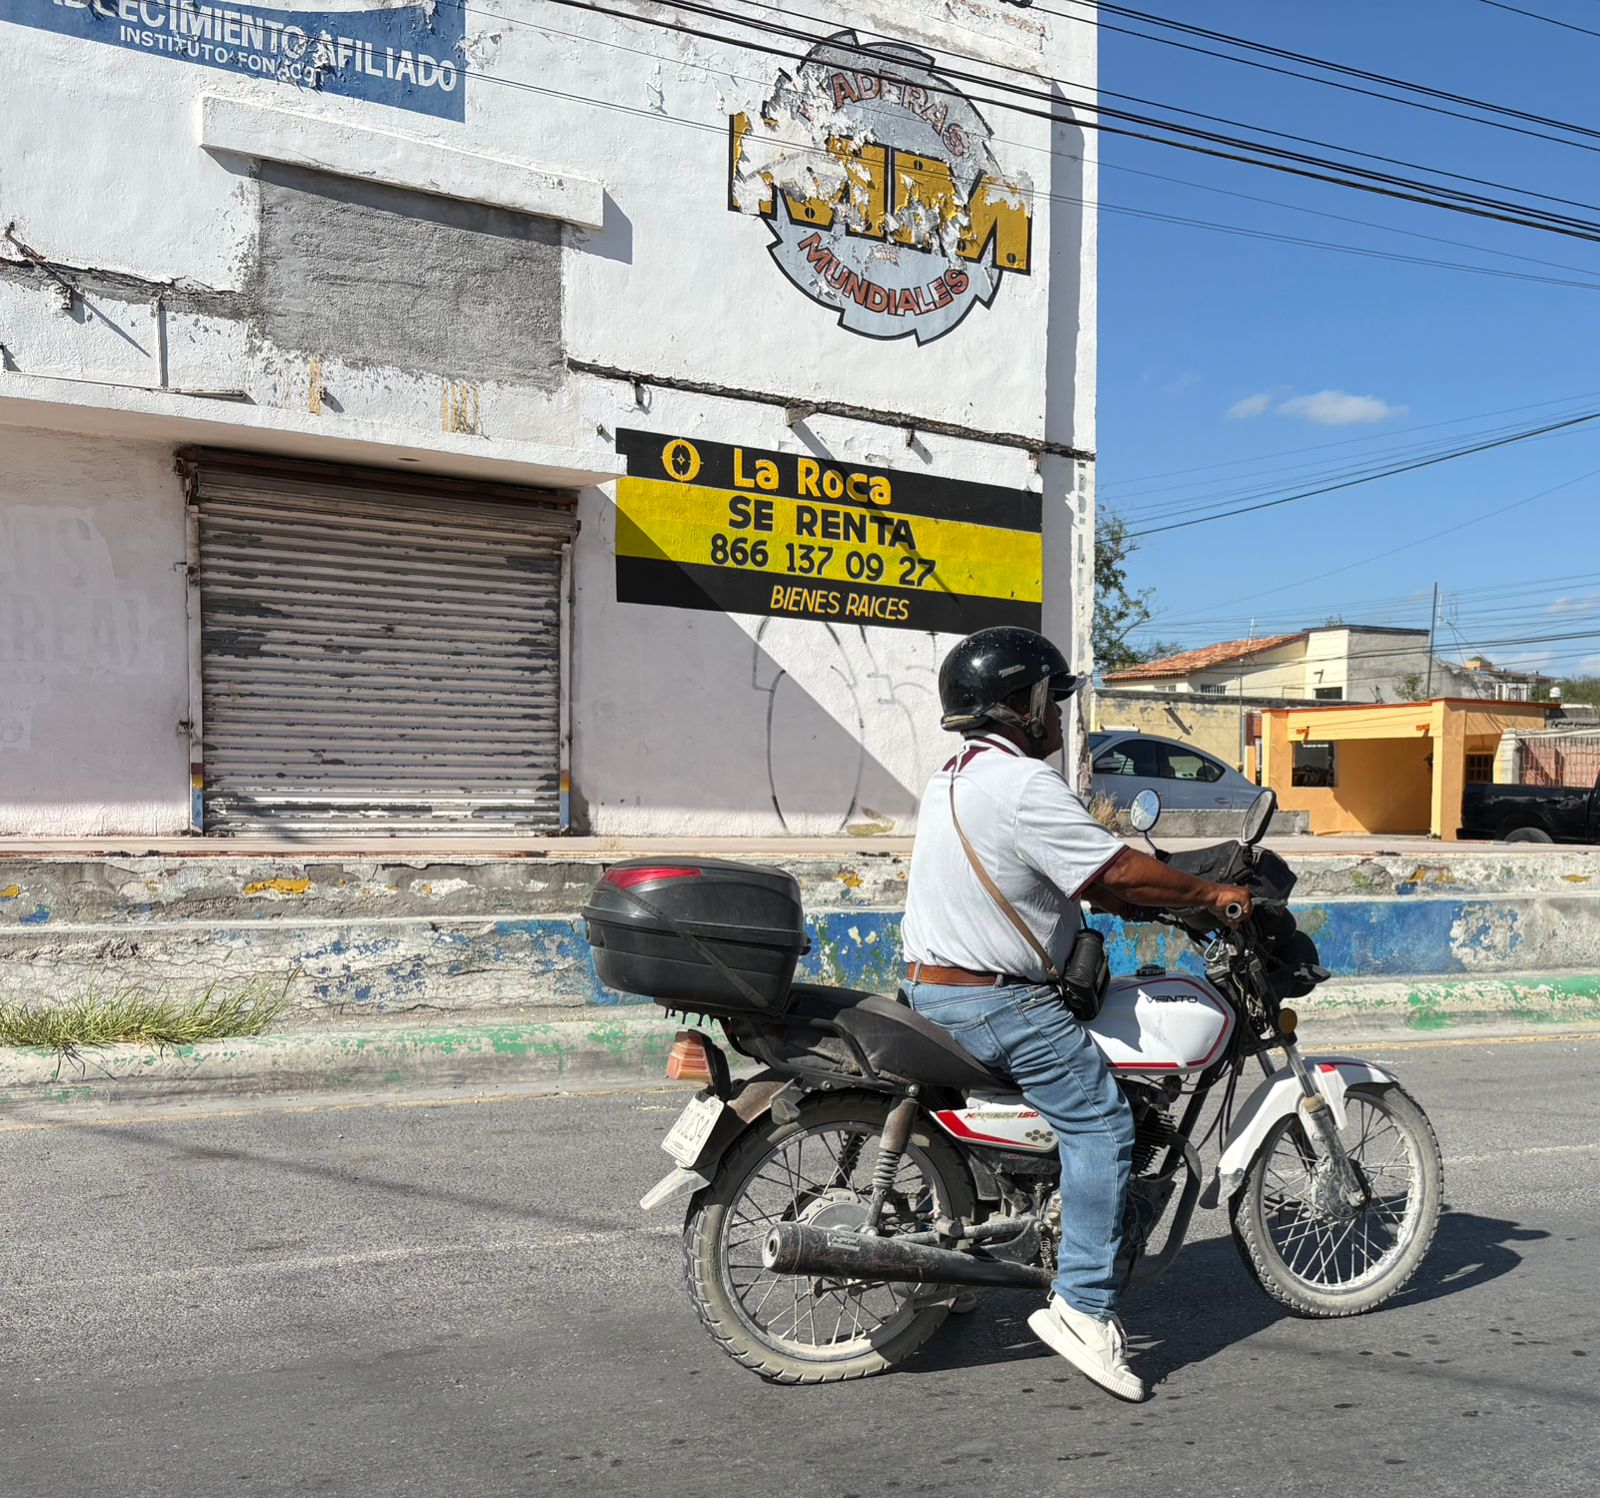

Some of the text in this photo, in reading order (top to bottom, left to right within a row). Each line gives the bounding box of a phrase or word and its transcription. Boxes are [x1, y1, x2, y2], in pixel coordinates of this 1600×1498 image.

[119, 25, 229, 64] INSTITUTO
[800, 68, 970, 157] ADERAS
[798, 231, 970, 317] MUNDIALES
[733, 448, 780, 490] La
[797, 458, 892, 506] Roca
[728, 495, 917, 550] SE RENTA
[710, 533, 937, 587] 866 137 09 27
[770, 585, 910, 621] BIENES RAICES
[1146, 995, 1198, 1003] VENTO
